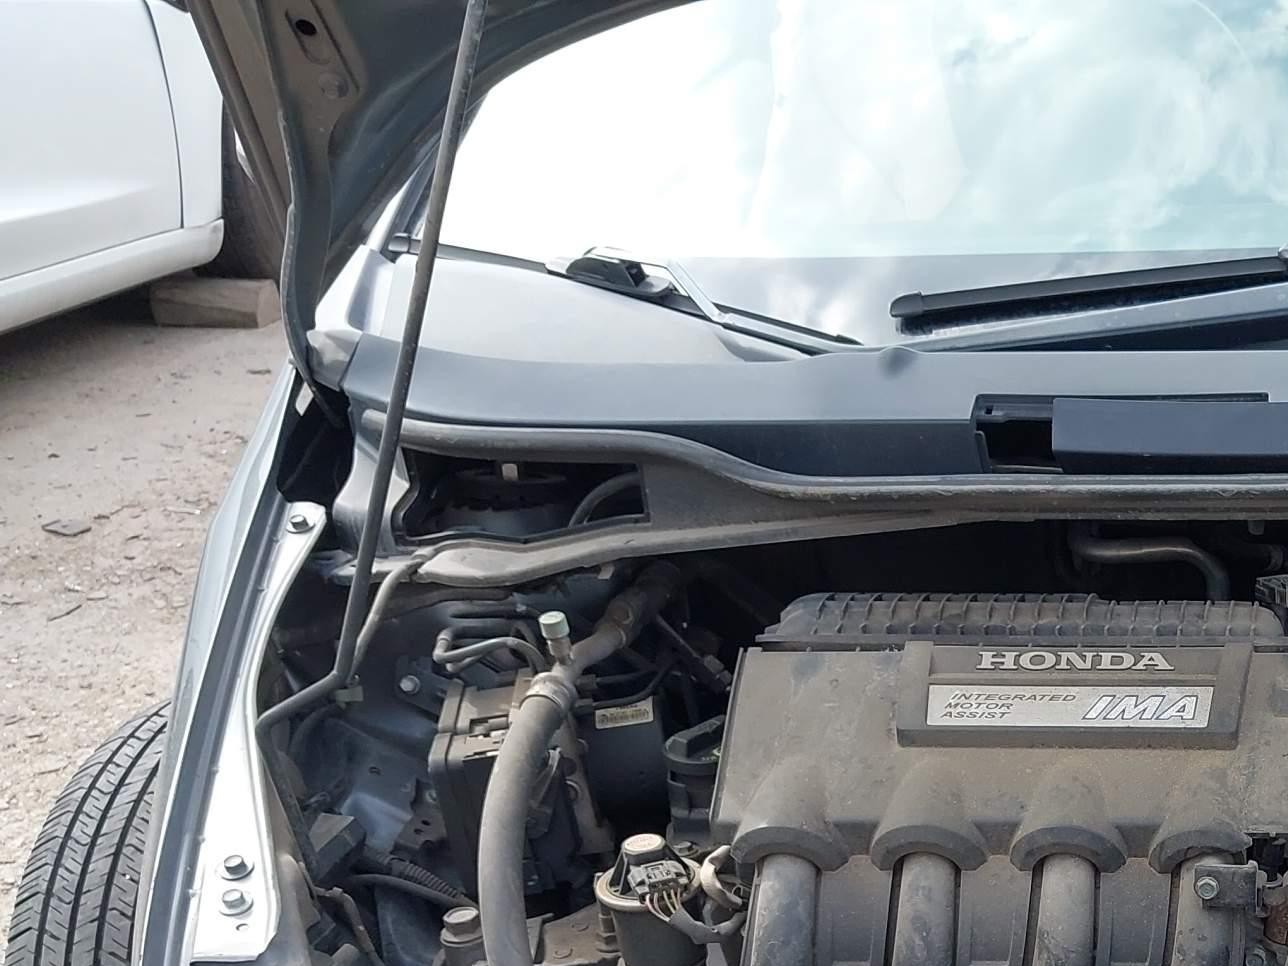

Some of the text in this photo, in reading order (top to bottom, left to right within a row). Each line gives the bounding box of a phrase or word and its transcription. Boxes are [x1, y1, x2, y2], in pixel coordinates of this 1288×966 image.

[976, 651, 1175, 671] HONDA
[951, 693, 1077, 702] INTEGRATED
[944, 702, 1014, 710] MOTOR
[1081, 694, 1199, 720] IMA
[940, 711, 1012, 719] ASSIST
